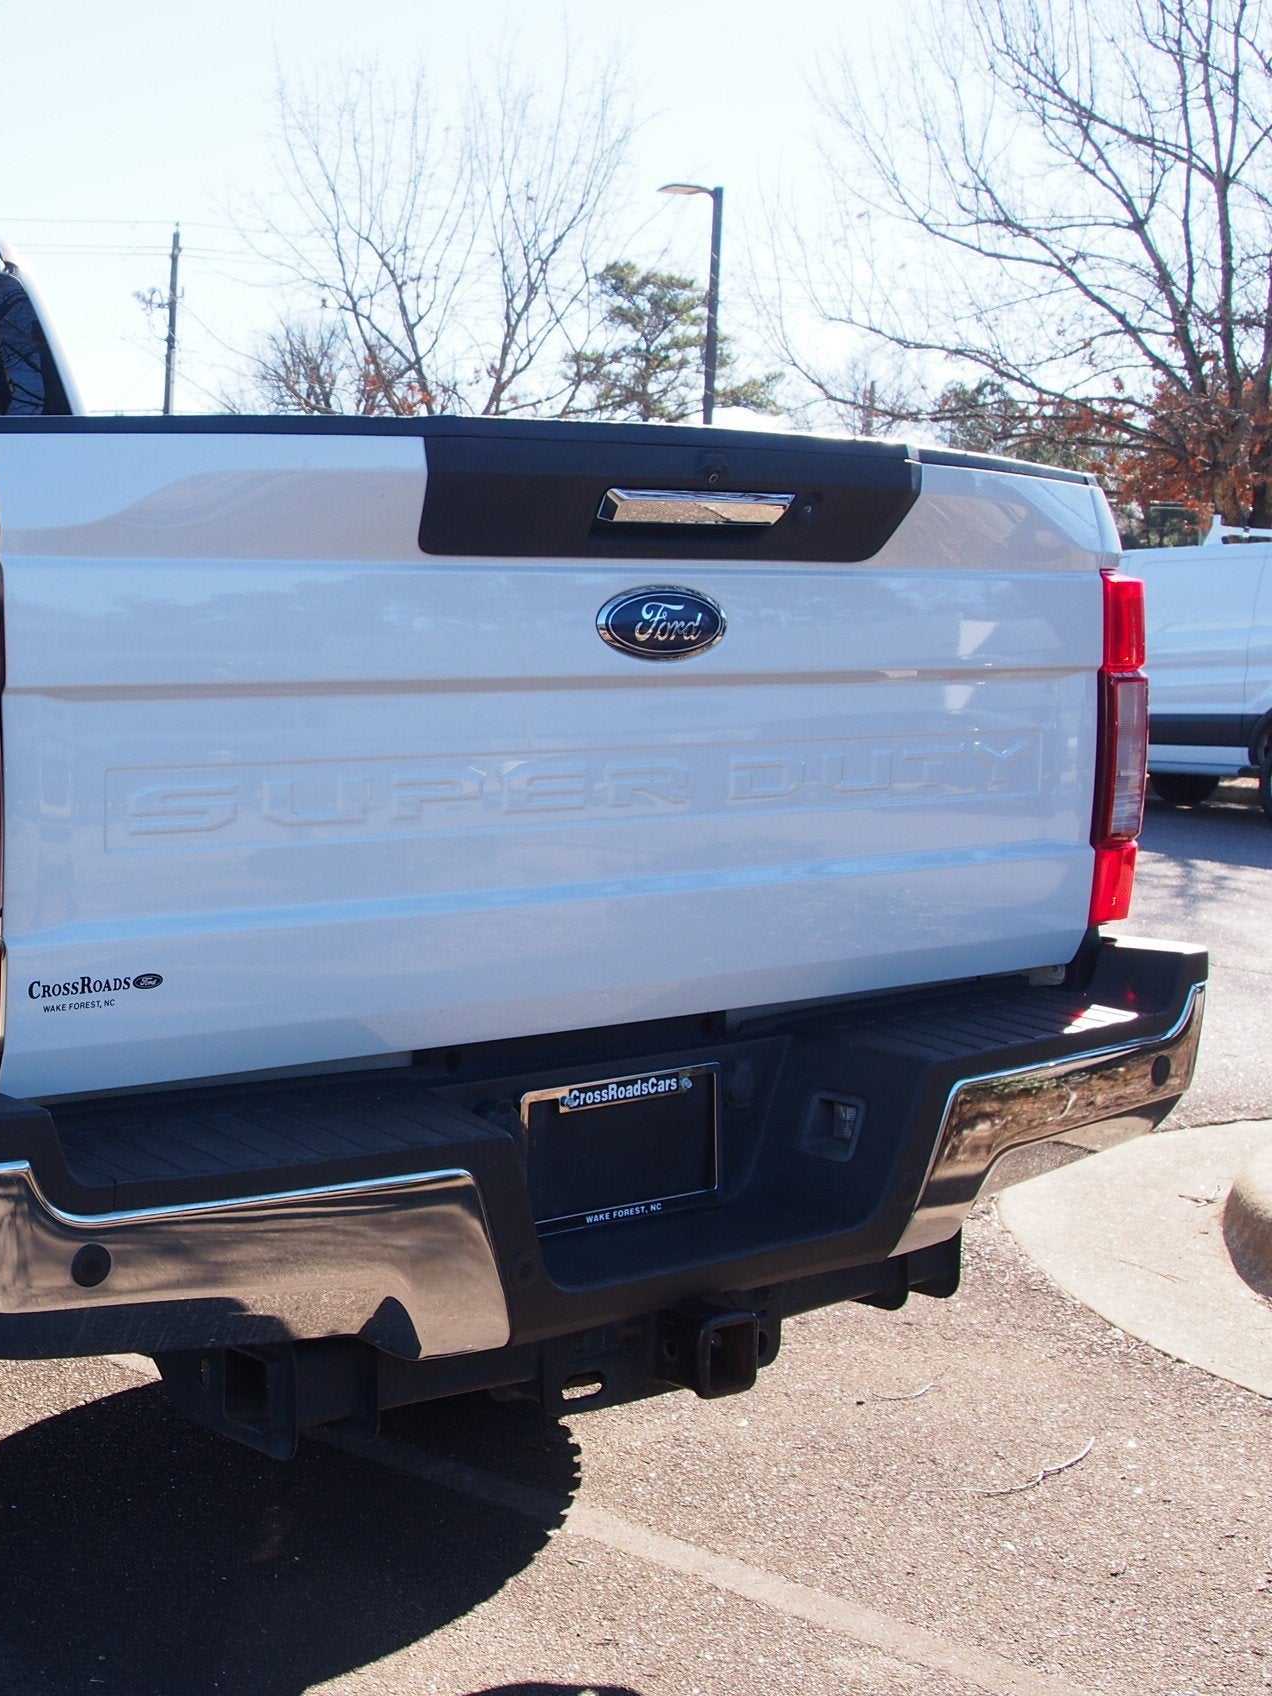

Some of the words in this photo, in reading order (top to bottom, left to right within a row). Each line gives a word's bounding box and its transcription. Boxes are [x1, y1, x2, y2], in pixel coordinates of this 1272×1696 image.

[634, 602, 703, 642] Ford
[128, 758, 690, 836] SUPER
[729, 739, 1030, 801] DUTY
[43, 1003, 66, 1013] WAKE
[68, 1000, 102, 1010] FOREST,
[104, 998, 116, 1007] NC
[569, 1077, 678, 1107] CrossRoadsCars
[585, 1212, 611, 1224] WAKE
[612, 1205, 648, 1219] FOREST,
[650, 1202, 663, 1212] NC
